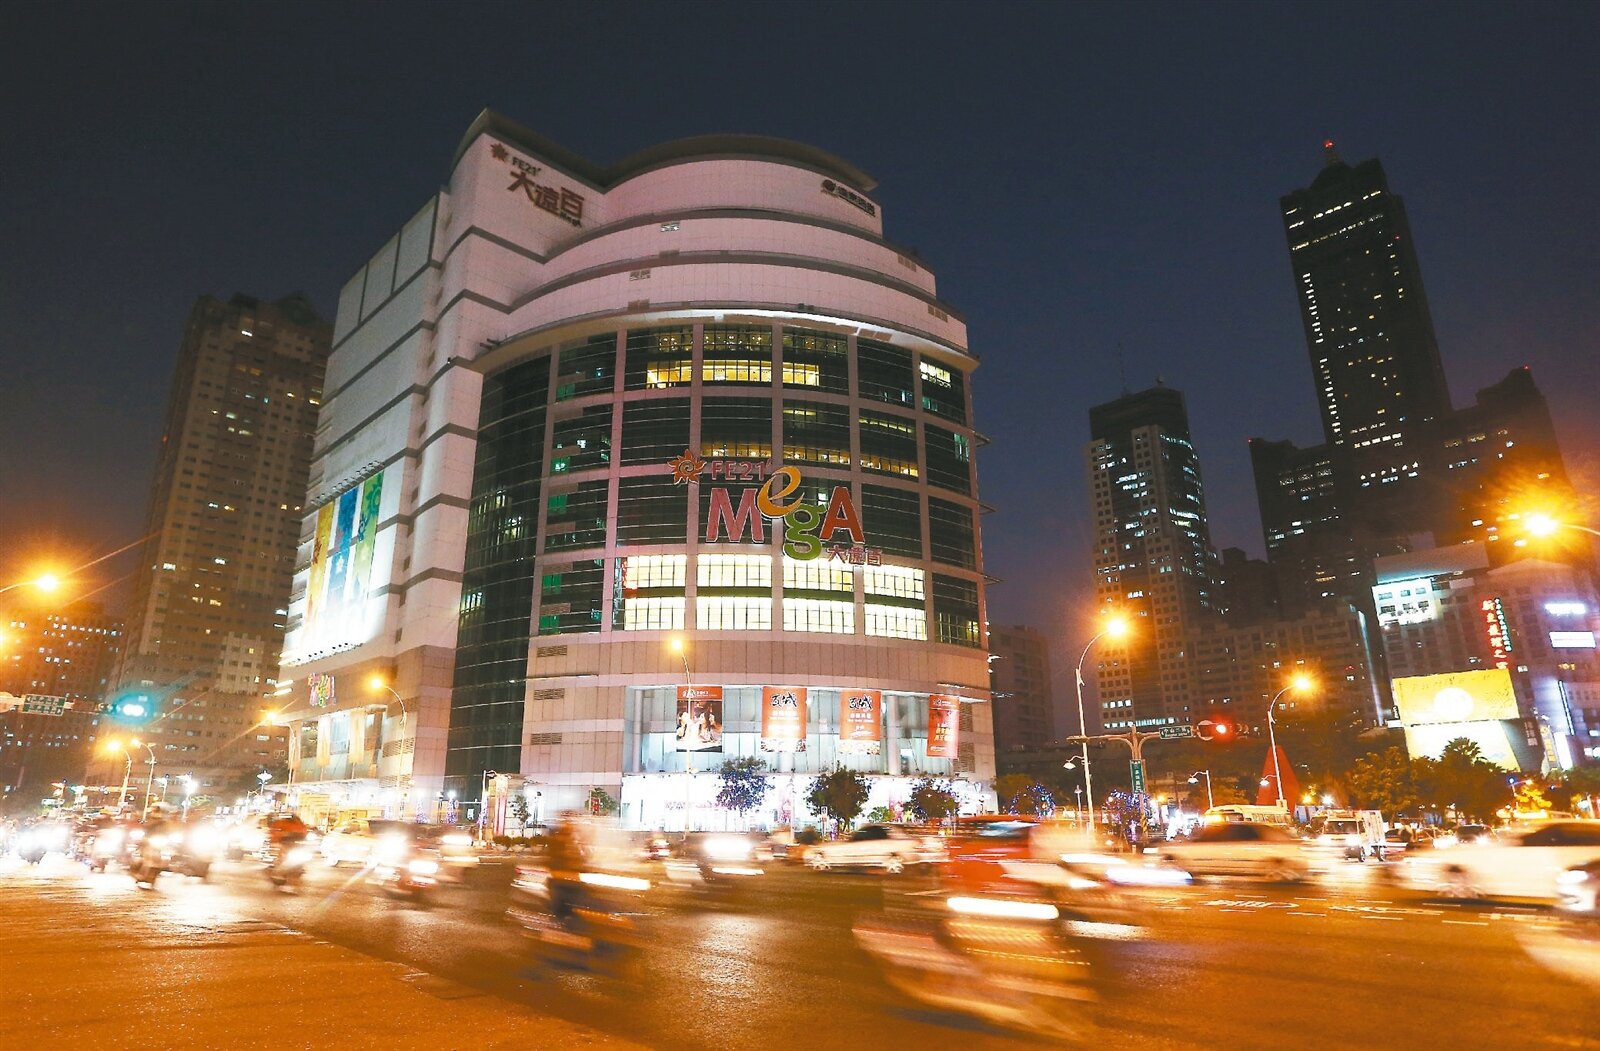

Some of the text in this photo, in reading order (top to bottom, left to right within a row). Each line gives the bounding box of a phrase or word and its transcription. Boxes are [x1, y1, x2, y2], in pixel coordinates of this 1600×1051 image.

[507, 170, 585, 219] 大遠百
[826, 544, 883, 566] 大遠百
